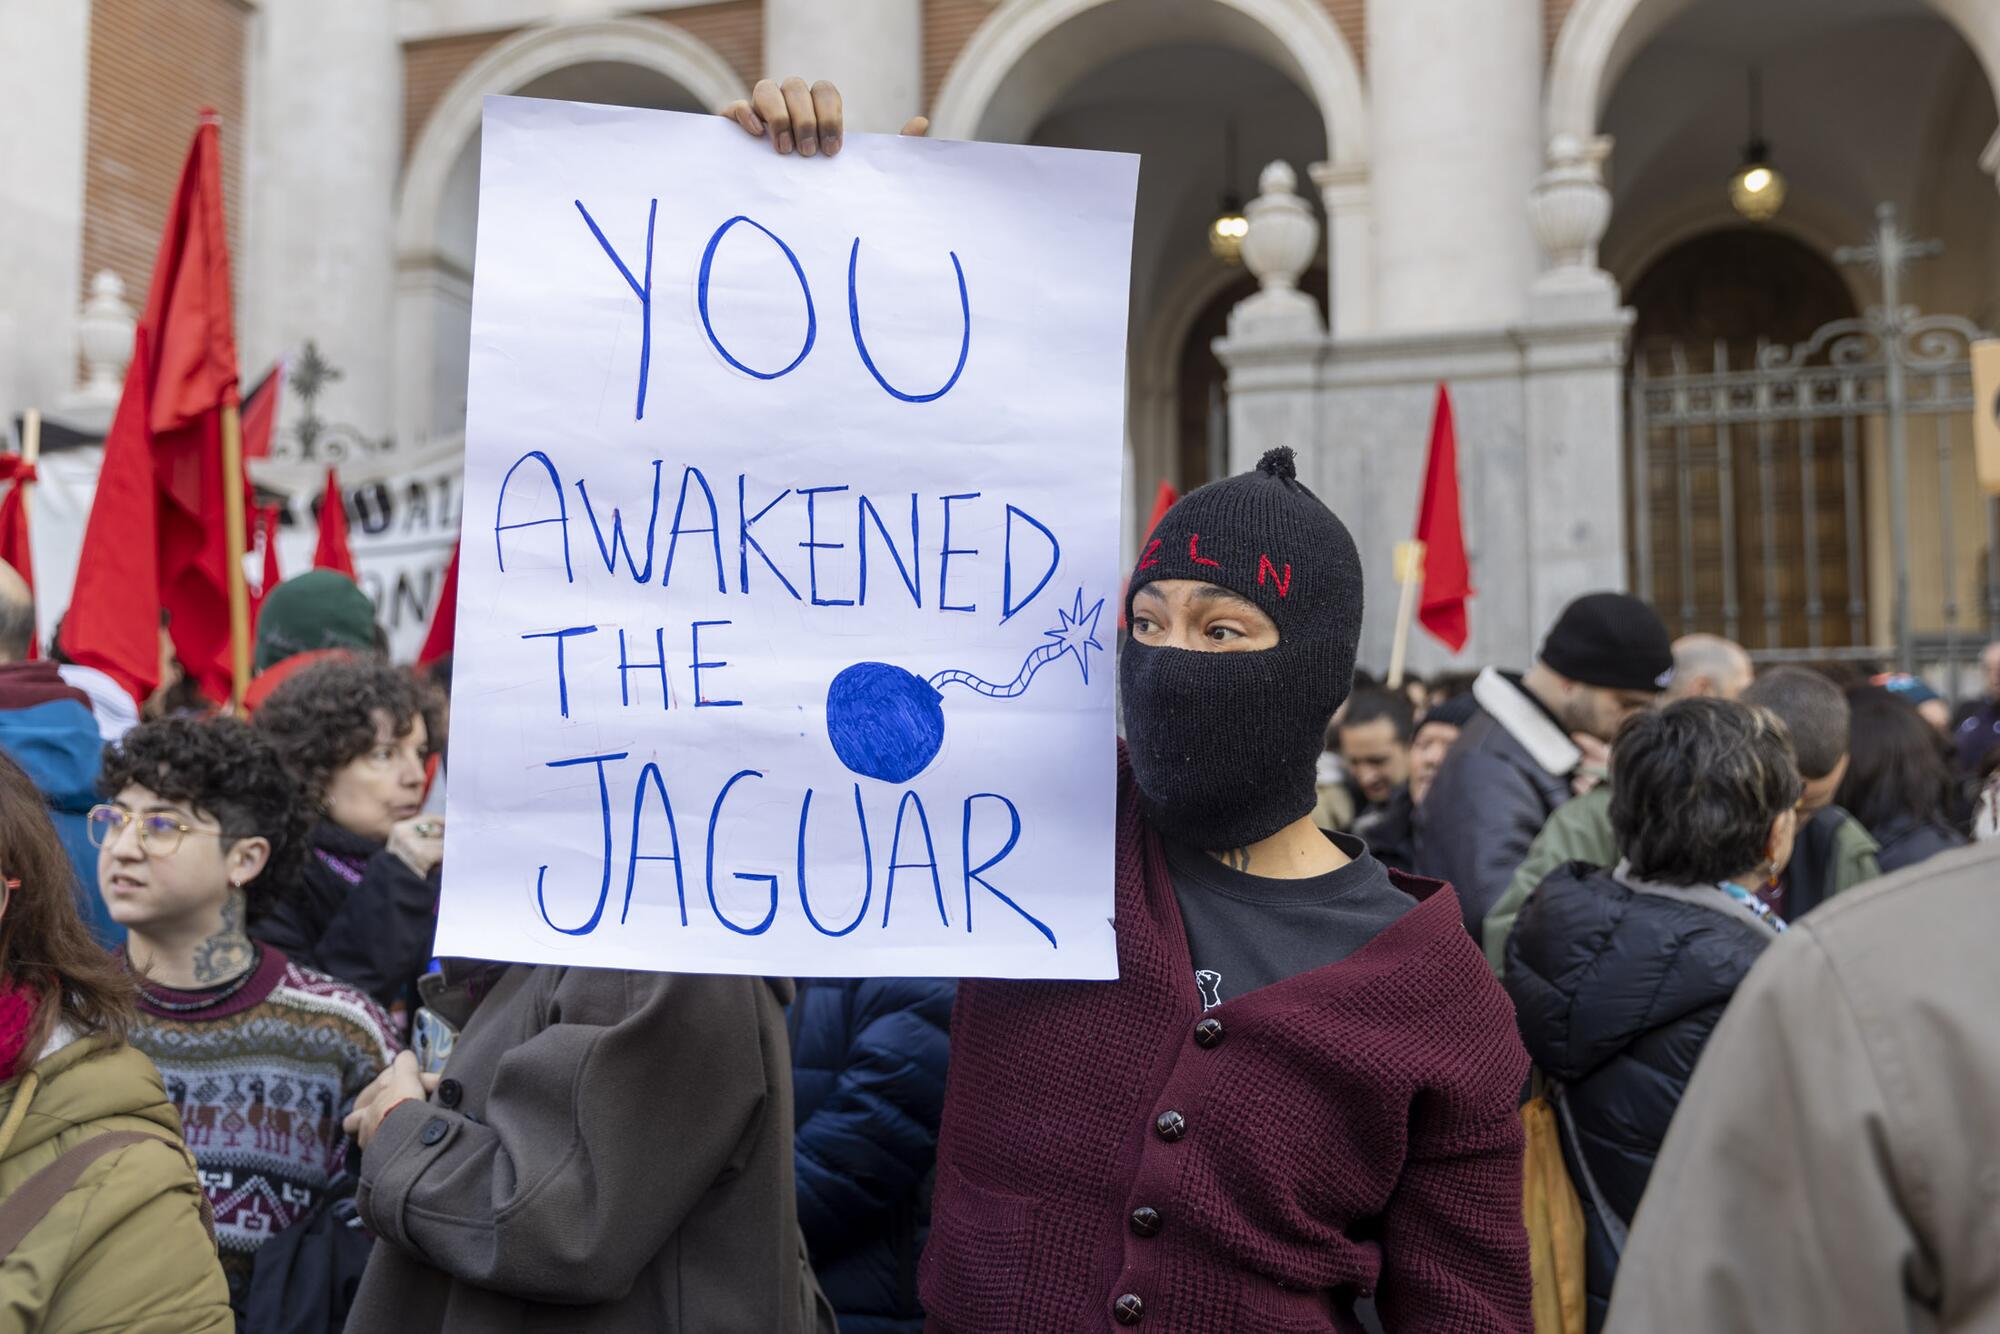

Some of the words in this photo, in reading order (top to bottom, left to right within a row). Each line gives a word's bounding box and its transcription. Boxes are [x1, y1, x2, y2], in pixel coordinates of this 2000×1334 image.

[575, 198, 971, 421] YOU
[494, 450, 1062, 626] AWAKENED
[520, 619, 744, 719] THE
[537, 751, 1058, 949] JAGUAR
